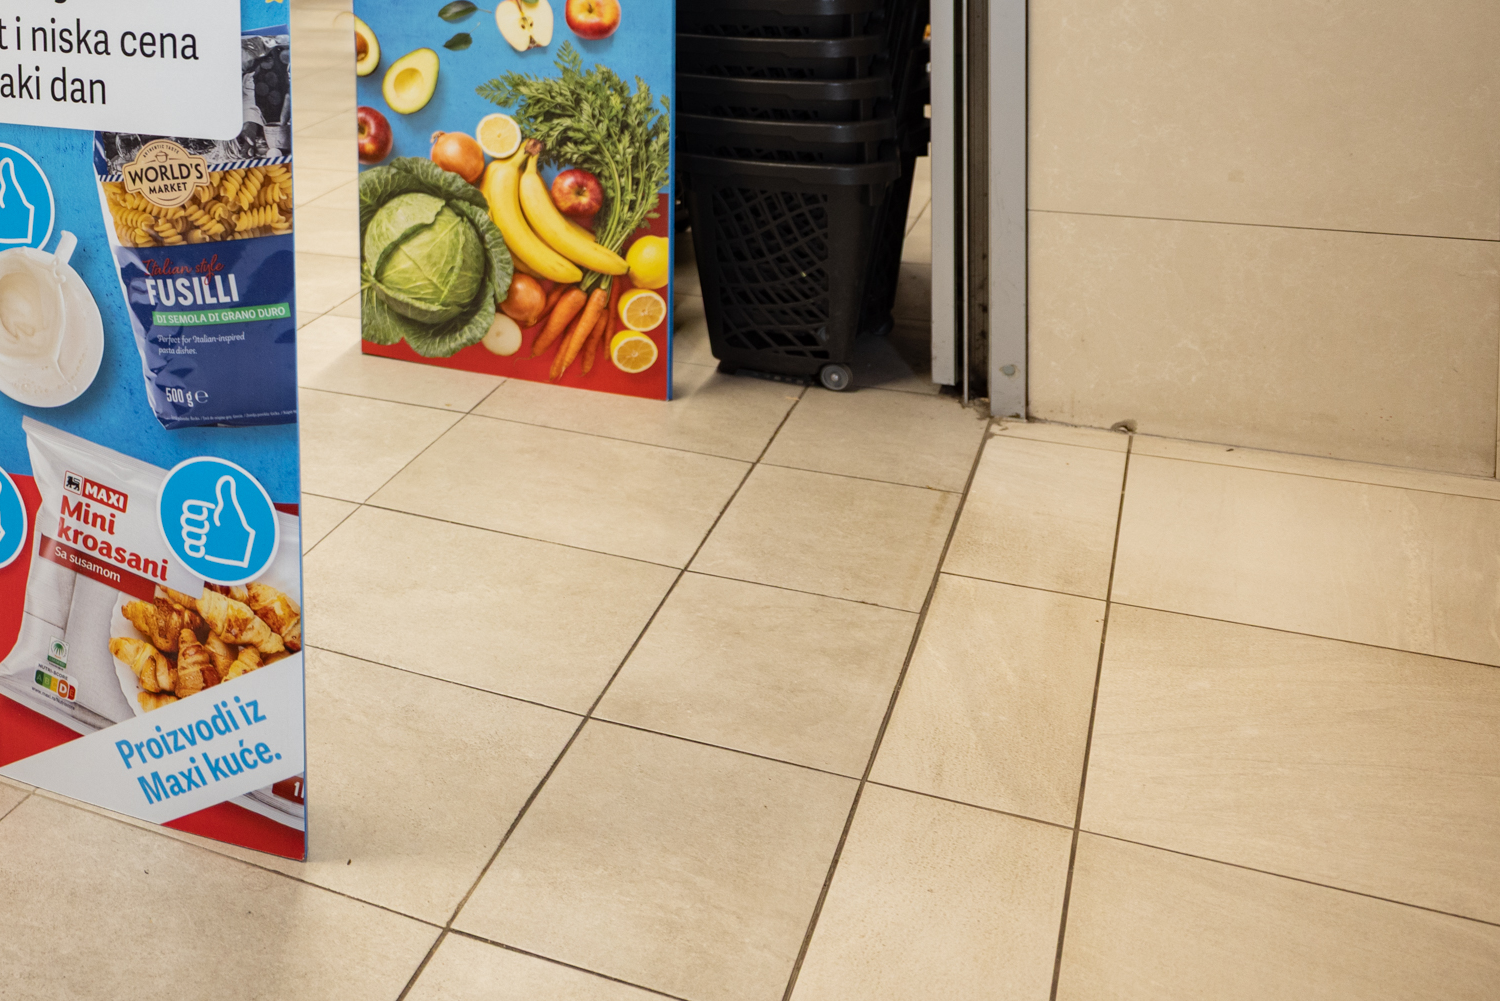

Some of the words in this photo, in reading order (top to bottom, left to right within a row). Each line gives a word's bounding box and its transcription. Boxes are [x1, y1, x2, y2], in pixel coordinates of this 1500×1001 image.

[15, 15, 22, 51] i
[31, 18, 111, 56] niska
[120, 30, 199, 60] cena
[50, 67, 107, 105] dan
[128, 163, 204, 187] WORLD'S
[148, 182, 188, 195] MARKET
[142, 258, 192, 277] Italian
[196, 254, 225, 286] style
[145, 273, 240, 307] FUSILLI
[156, 314, 167, 324] DI
[168, 311, 207, 324] SEMOLA
[208, 311, 220, 323] DI
[222, 308, 256, 322] GRANO
[257, 306, 286, 318] DURO
[157, 334, 180, 346] Perfect
[182, 335, 192, 346] for
[165, 387, 185, 403] 500
[186, 391, 194, 408] g
[84, 482, 125, 510] MAXI
[60, 494, 117, 536] Mini
[54, 546, 68, 560] Sa
[69, 553, 121, 583] susamom
[57, 516, 169, 582] kroasani
[38, 663, 68, 681] NUTRI-SCORE
[114, 700, 240, 770] Proizvodi
[233, 695, 267, 726] iz
[137, 756, 208, 805] Maxi
[201, 739, 283, 783] kuće.
